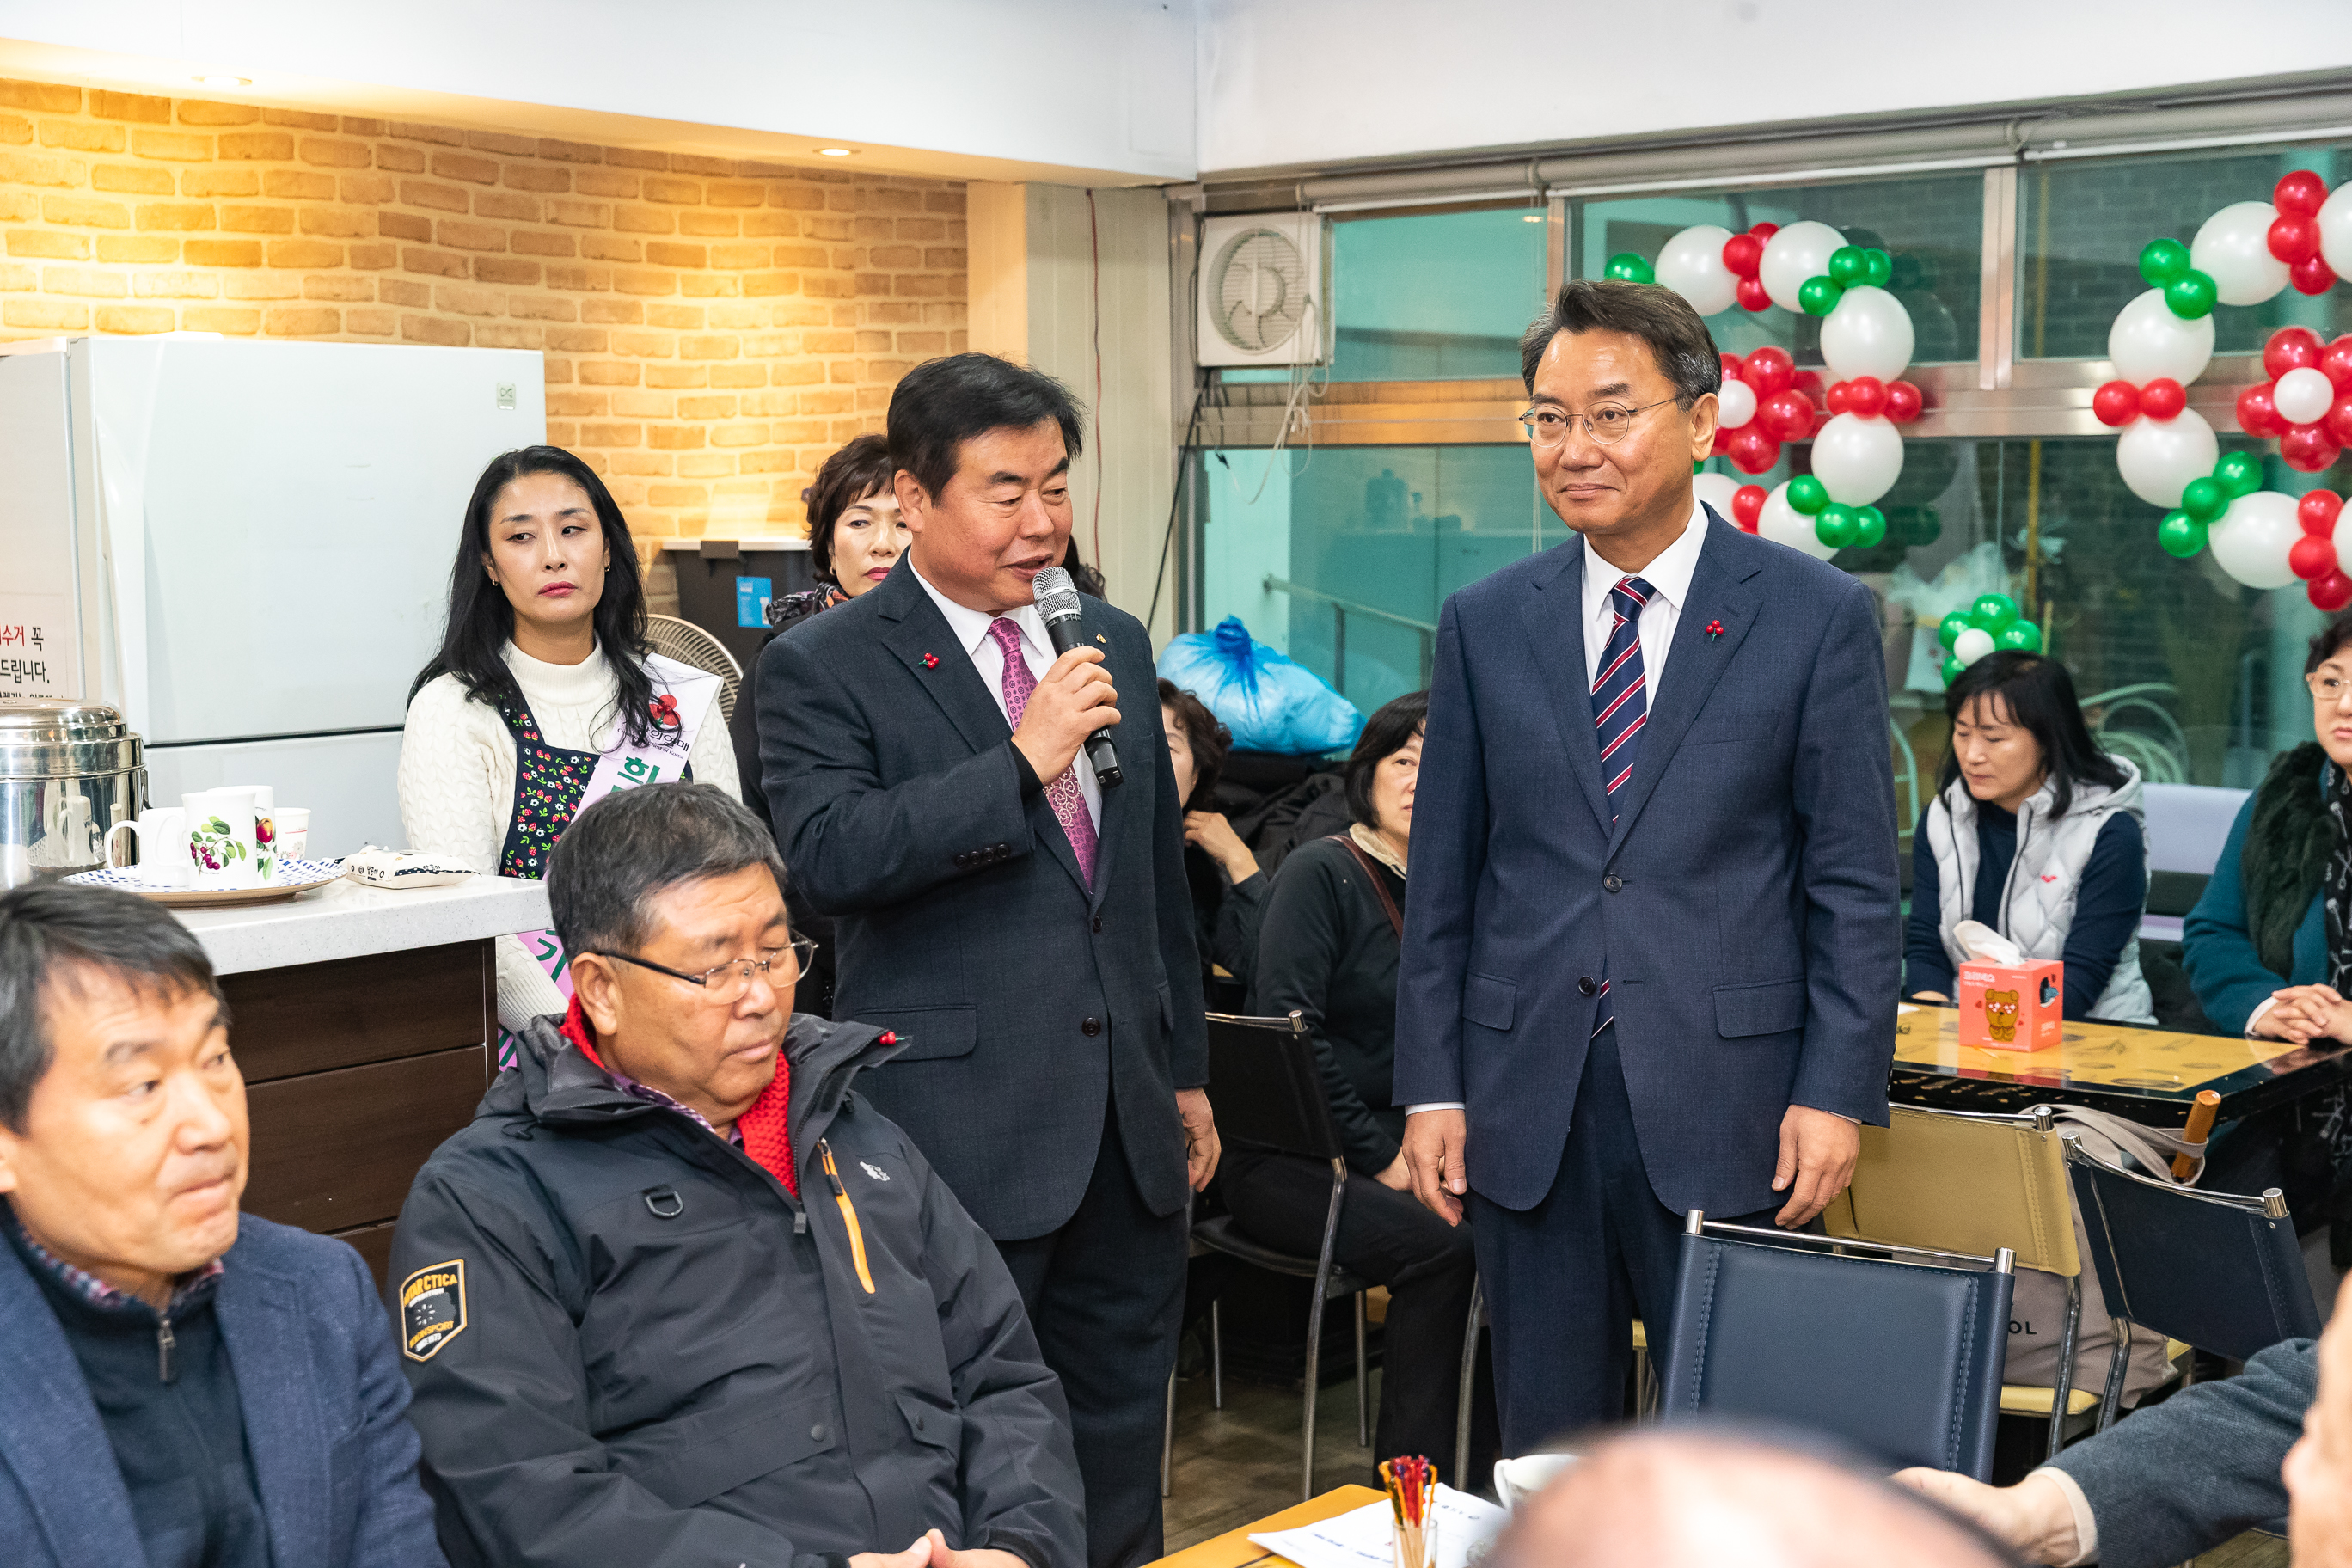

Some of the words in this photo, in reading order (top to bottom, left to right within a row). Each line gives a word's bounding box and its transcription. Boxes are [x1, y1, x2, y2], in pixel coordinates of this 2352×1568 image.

[0, 625, 24, 646] 수거
[31, 627, 44, 651] 꼭
[0, 659, 50, 683] 드립니다.
